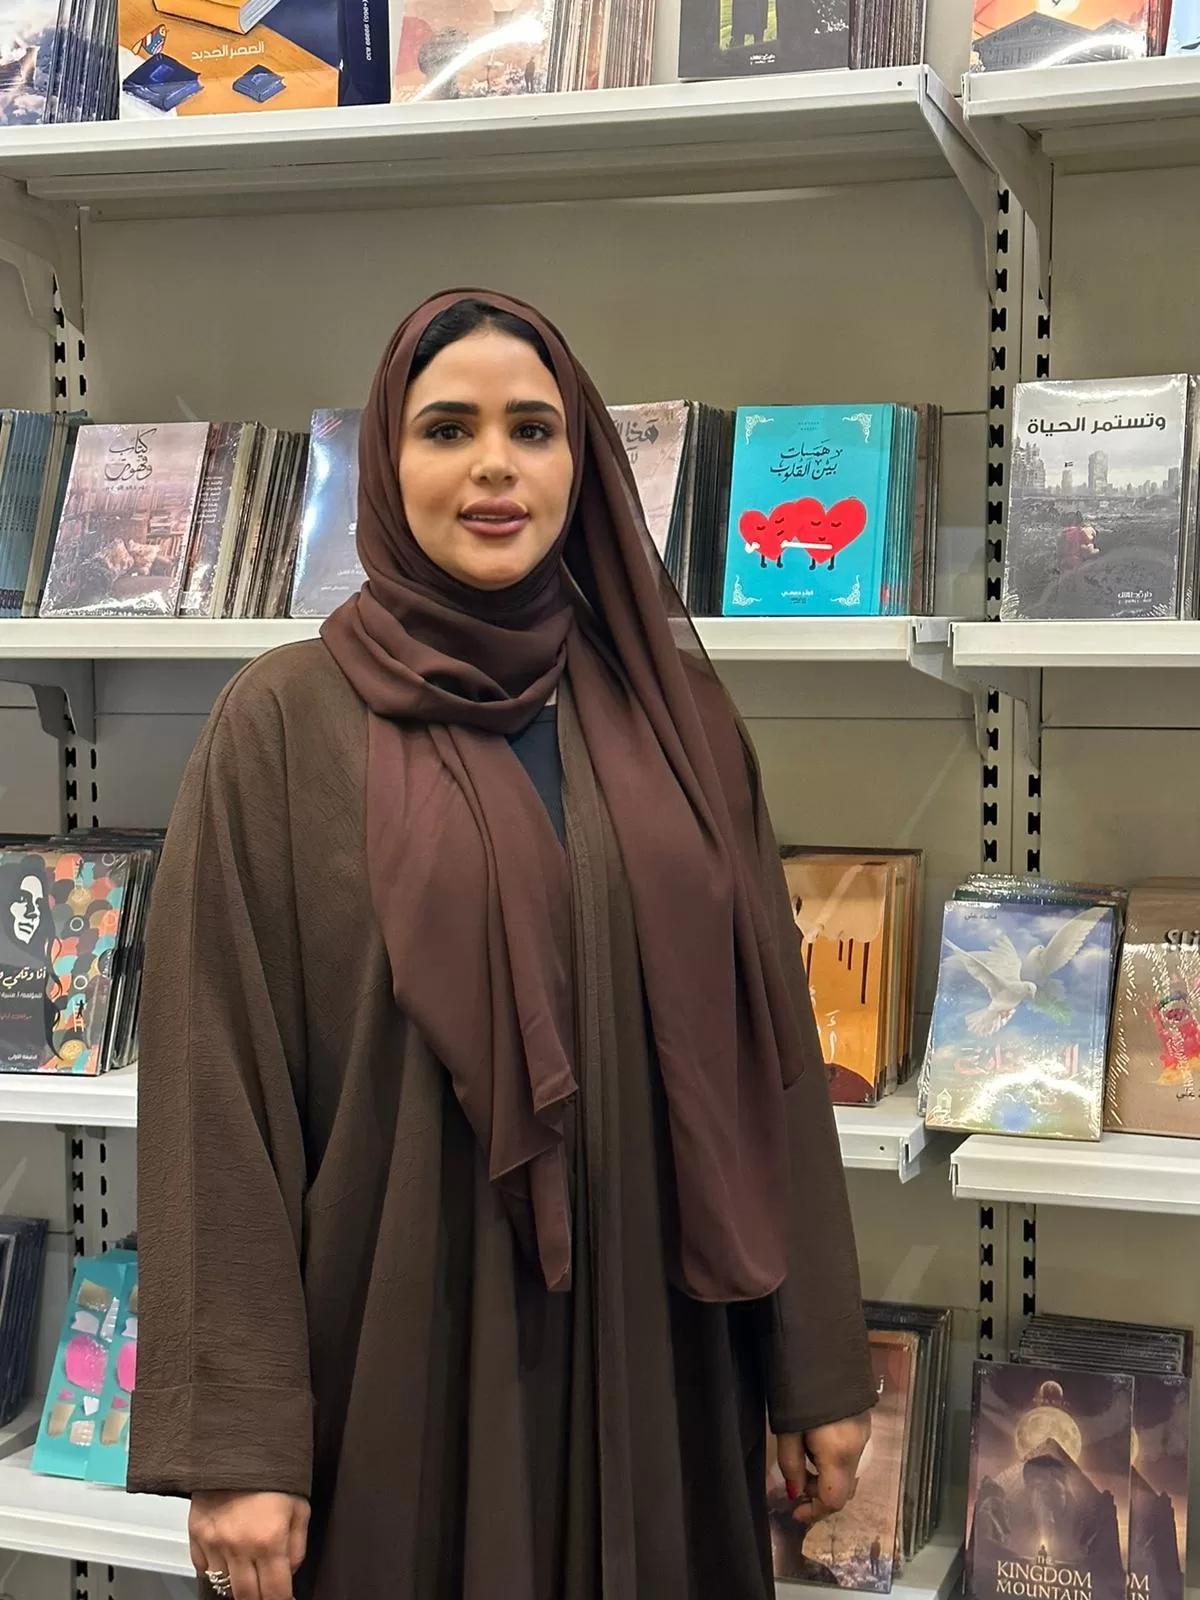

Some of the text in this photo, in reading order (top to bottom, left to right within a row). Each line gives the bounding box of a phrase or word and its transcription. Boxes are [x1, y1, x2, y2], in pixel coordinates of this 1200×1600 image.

[191, 44, 229, 62] الجديد
[1027, 412, 1167, 437] وتستمر الحياة
[109, 427, 157, 456] كتاب
[769, 457, 838, 483] بين القلوب
[2, 966, 47, 989] أنا وقلمي
[997, 1560, 1093, 1589] KINGDOM
[996, 1579, 1093, 1600] MOUNTAIN
